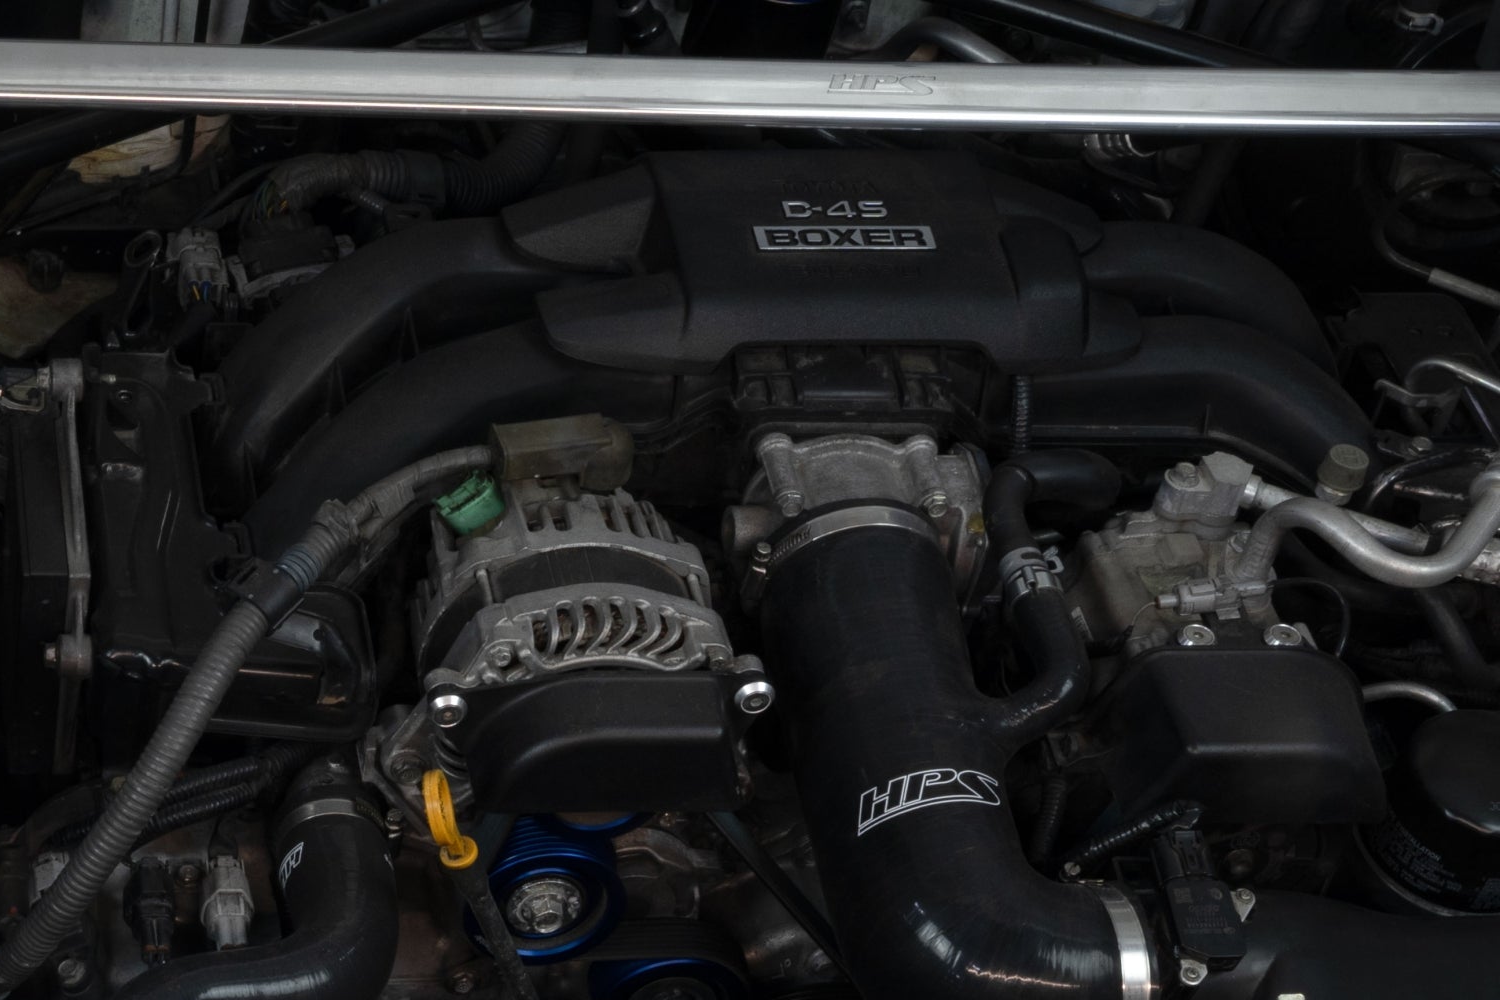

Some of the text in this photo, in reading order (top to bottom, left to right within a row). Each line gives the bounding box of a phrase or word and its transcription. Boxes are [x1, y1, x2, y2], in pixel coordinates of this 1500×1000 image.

[827, 73, 937, 96] HPS
[781, 199, 889, 219] D-4S
[764, 229, 928, 246] BOXER
[857, 767, 1001, 836] HPS
